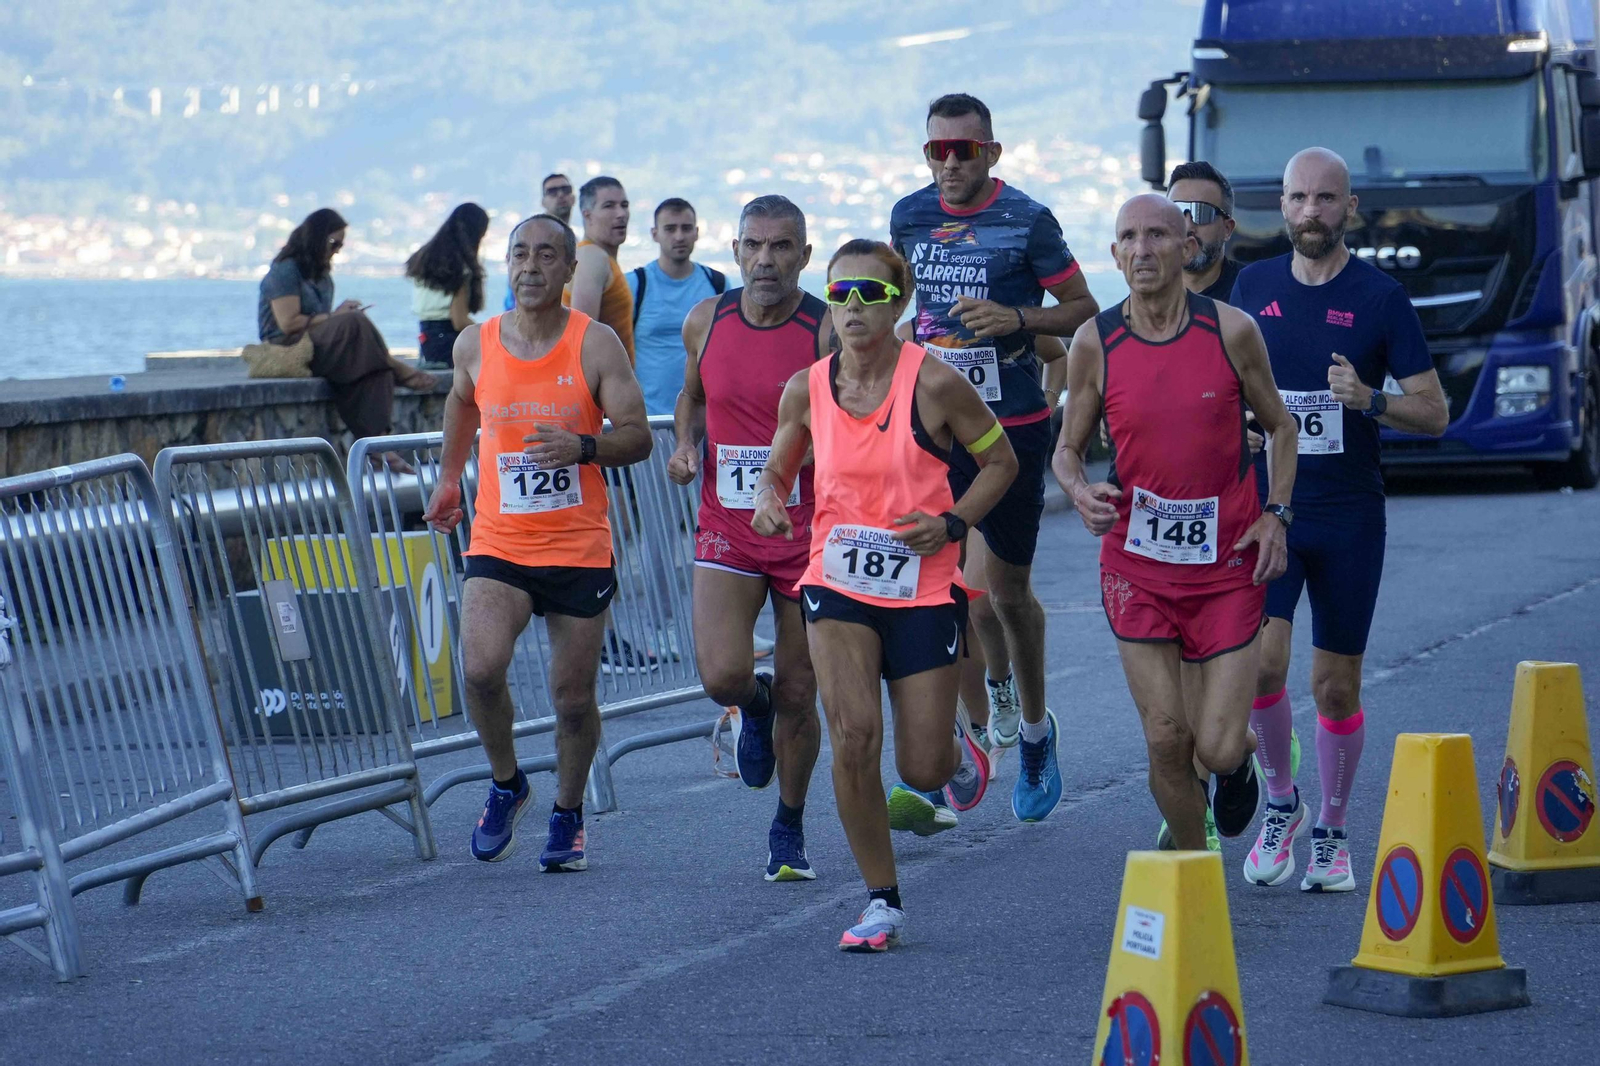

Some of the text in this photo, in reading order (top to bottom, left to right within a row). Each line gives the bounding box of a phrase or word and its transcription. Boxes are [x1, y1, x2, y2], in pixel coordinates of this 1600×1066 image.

[928, 243, 987, 266] FE seguros
[1349, 246, 1421, 269] ECO
[915, 263, 987, 284] CARREIRA
[916, 283, 940, 294] PRAIA
[931, 294, 941, 303] DE
[1327, 309, 1345, 317] BMW
[1326, 319, 1352, 328] MARATHON
[943, 351, 973, 361] ALFONSO
[974, 350, 994, 359] MORO
[1285, 394, 1317, 405] ALFONSO
[499, 455, 521, 466] 10KMS
[720, 448, 739, 459] 10KMS
[513, 468, 571, 497] 126
[731, 467, 763, 491] 13
[1158, 501, 1193, 514] ALFONSO
[833, 527, 858, 539] 10KMS
[858, 530, 895, 545] ALFONSO
[1147, 516, 1207, 546] 148
[842, 548, 910, 580] 187
[1256, 722, 1271, 767] COMPRESSPORT
[1335, 747, 1346, 796] COMPRESSPORT
